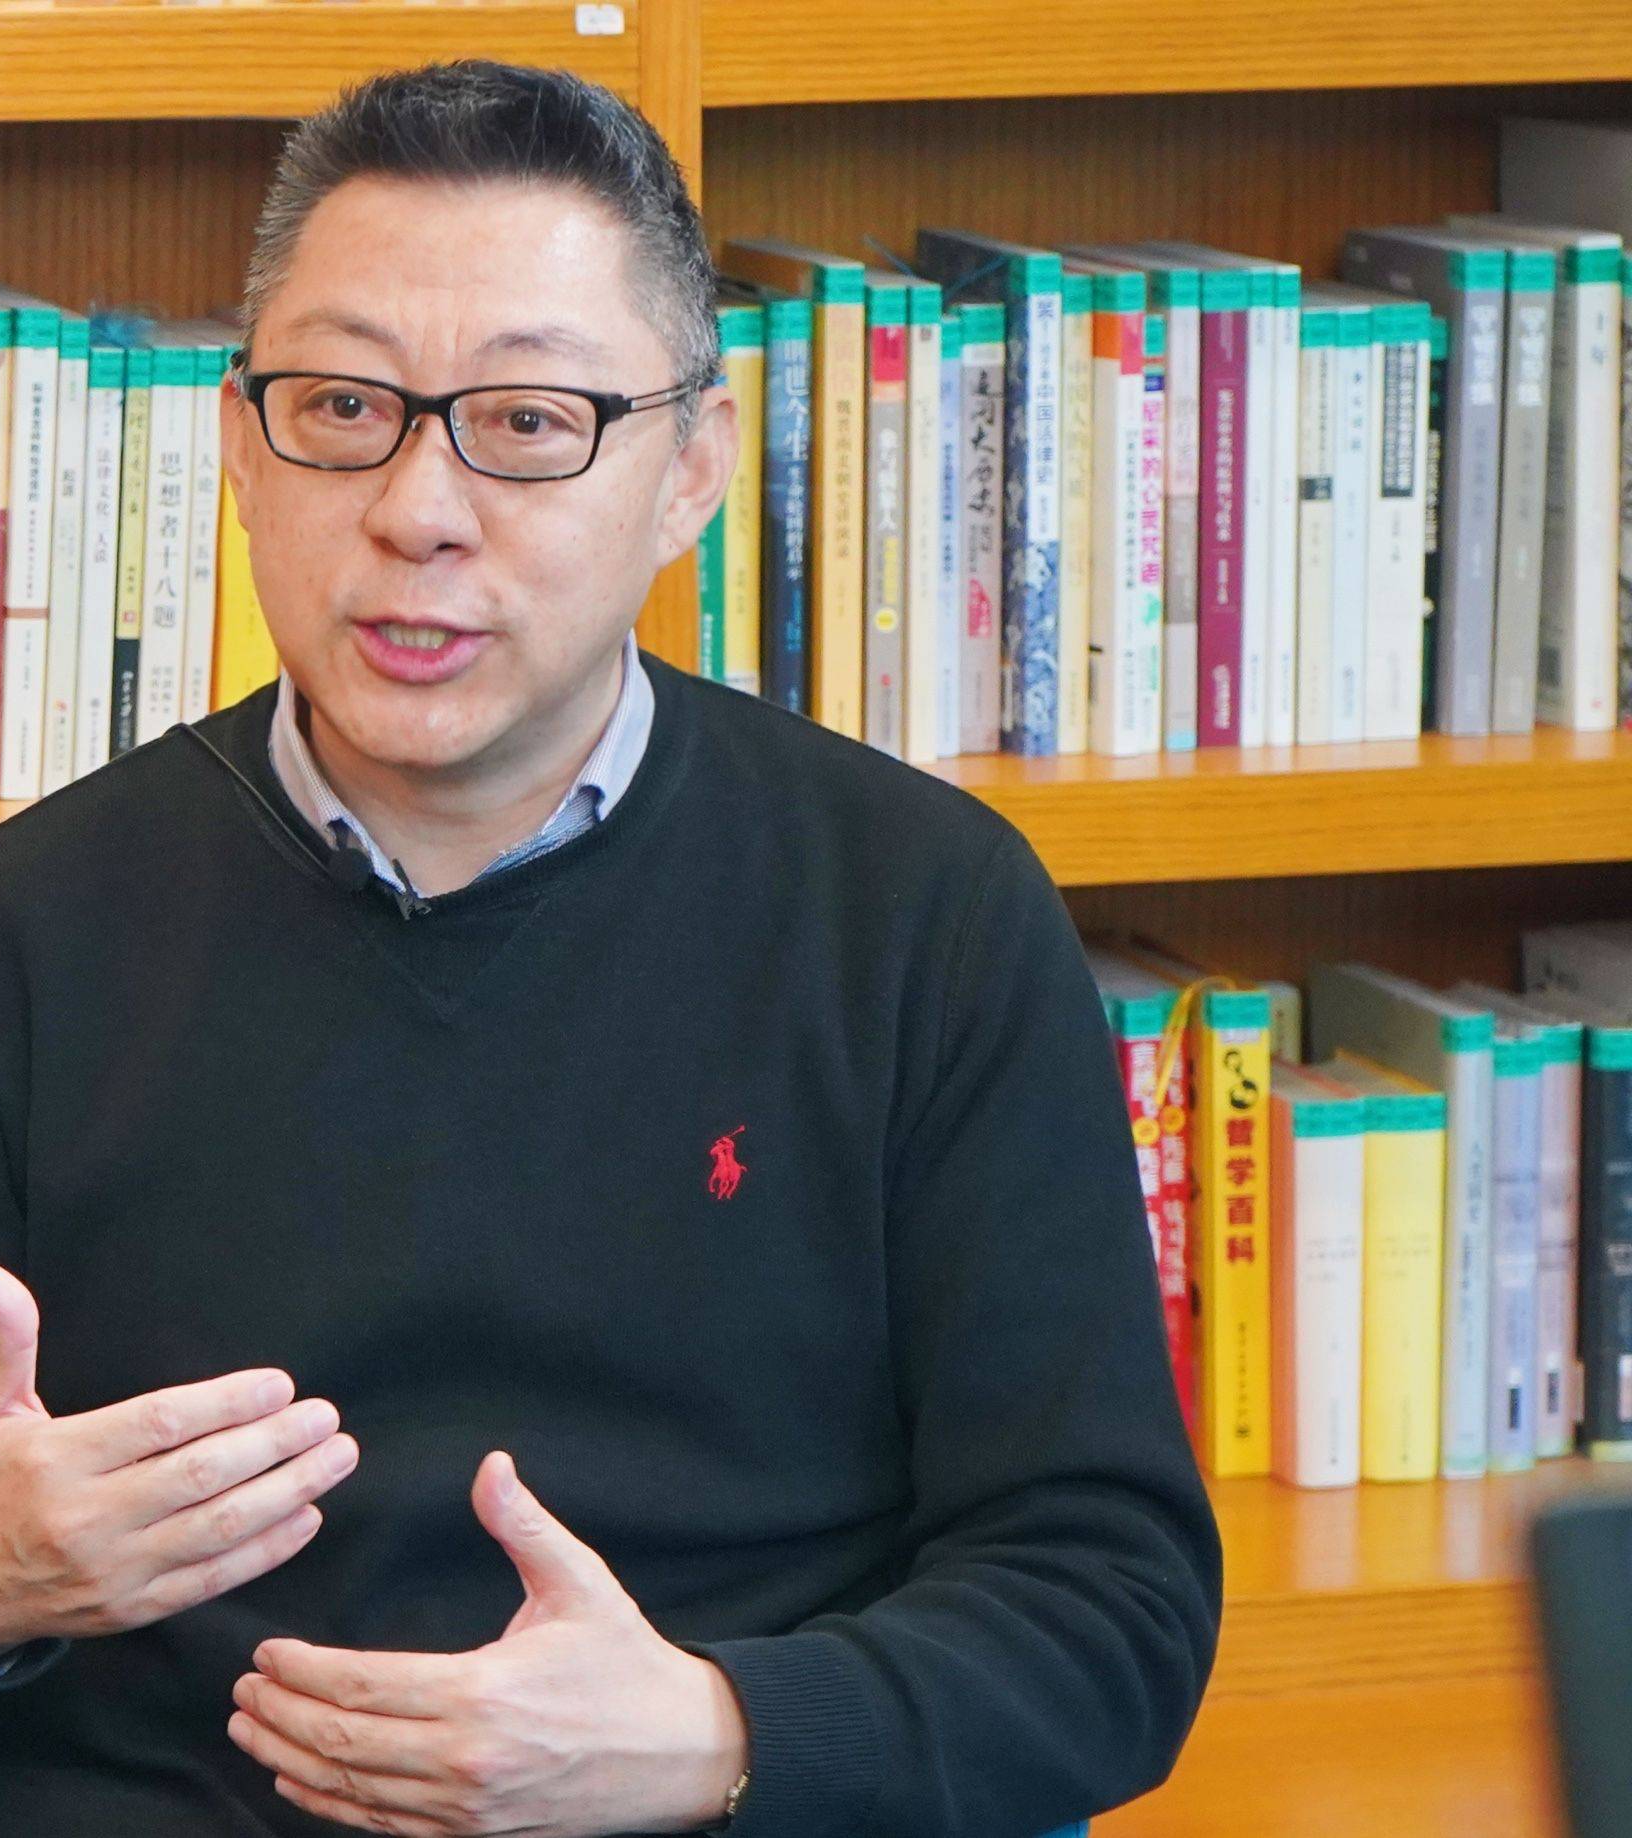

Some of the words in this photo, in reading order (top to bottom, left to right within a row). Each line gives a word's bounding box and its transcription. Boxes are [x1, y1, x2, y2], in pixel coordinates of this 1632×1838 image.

[153, 452, 183, 628] 思想者十八题
[1225, 1117, 1256, 1265] 哲学百科
